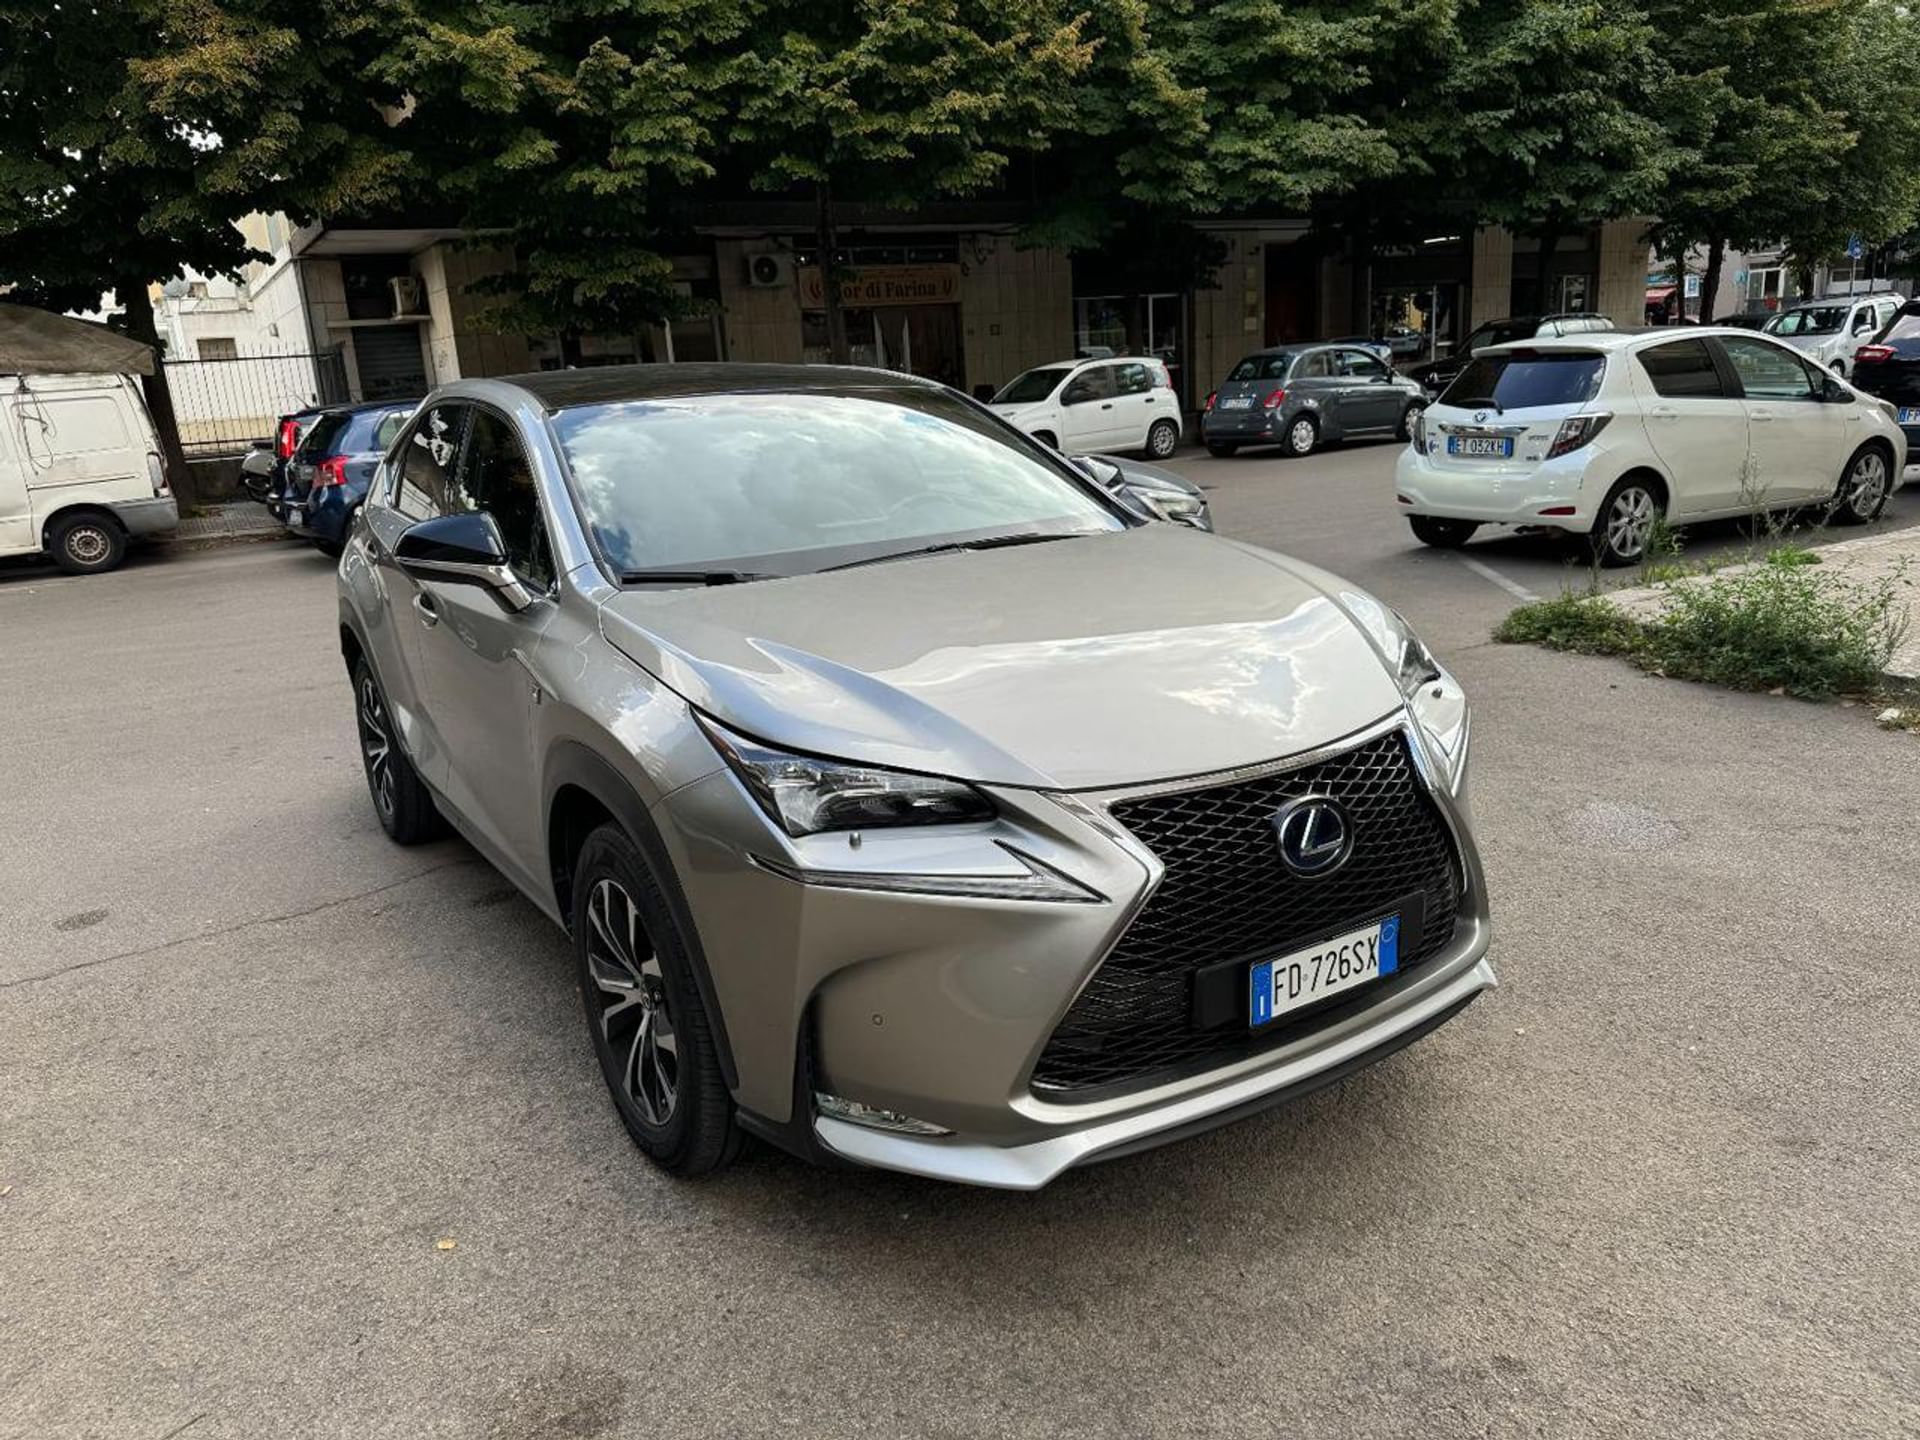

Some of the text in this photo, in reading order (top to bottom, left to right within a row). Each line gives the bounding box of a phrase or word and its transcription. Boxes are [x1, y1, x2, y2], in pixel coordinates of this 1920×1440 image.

[865, 281, 880, 298] di
[885, 280, 936, 298] Farina
[1470, 439, 1504, 454] 032KH
[1274, 963, 1301, 1006] FD
[1311, 934, 1378, 993] 726SX
